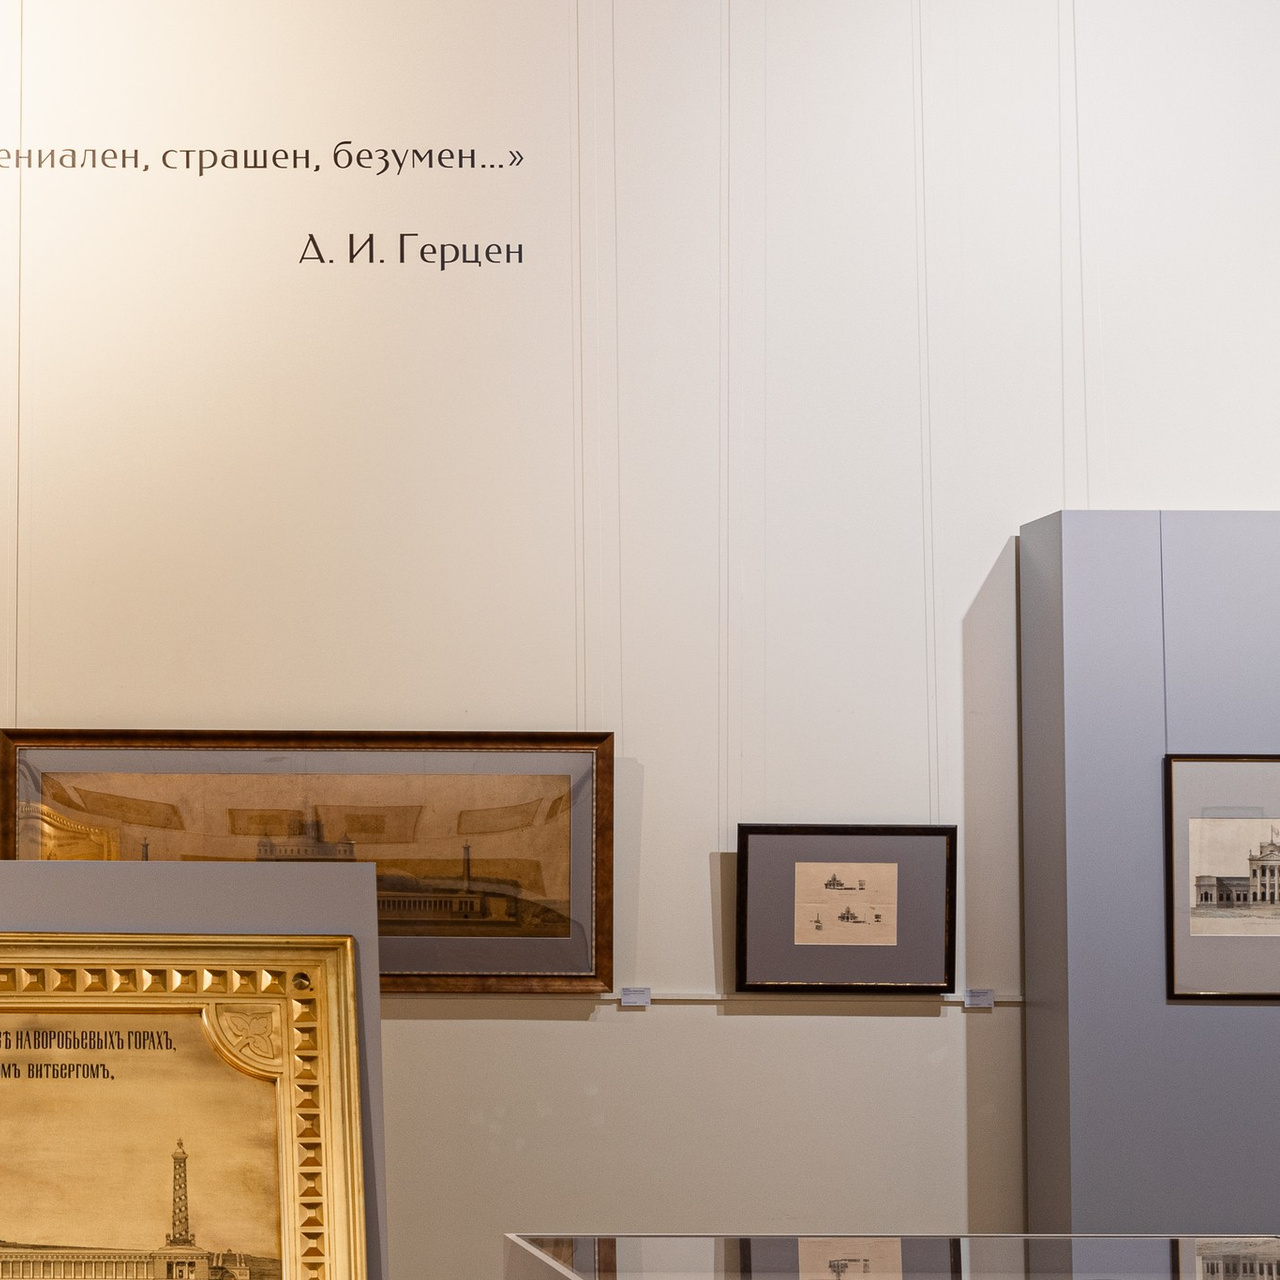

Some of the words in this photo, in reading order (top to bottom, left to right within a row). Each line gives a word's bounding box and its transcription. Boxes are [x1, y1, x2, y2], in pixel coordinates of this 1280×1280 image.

[161, 148, 320, 177] страшен,
[333, 140, 524, 176] безумен...»
[299, 233, 334, 264] А.
[349, 233, 385, 264] И.
[399, 233, 523, 271] Герцен
[127, 1030, 177, 1053] ГОРАХЪ,
